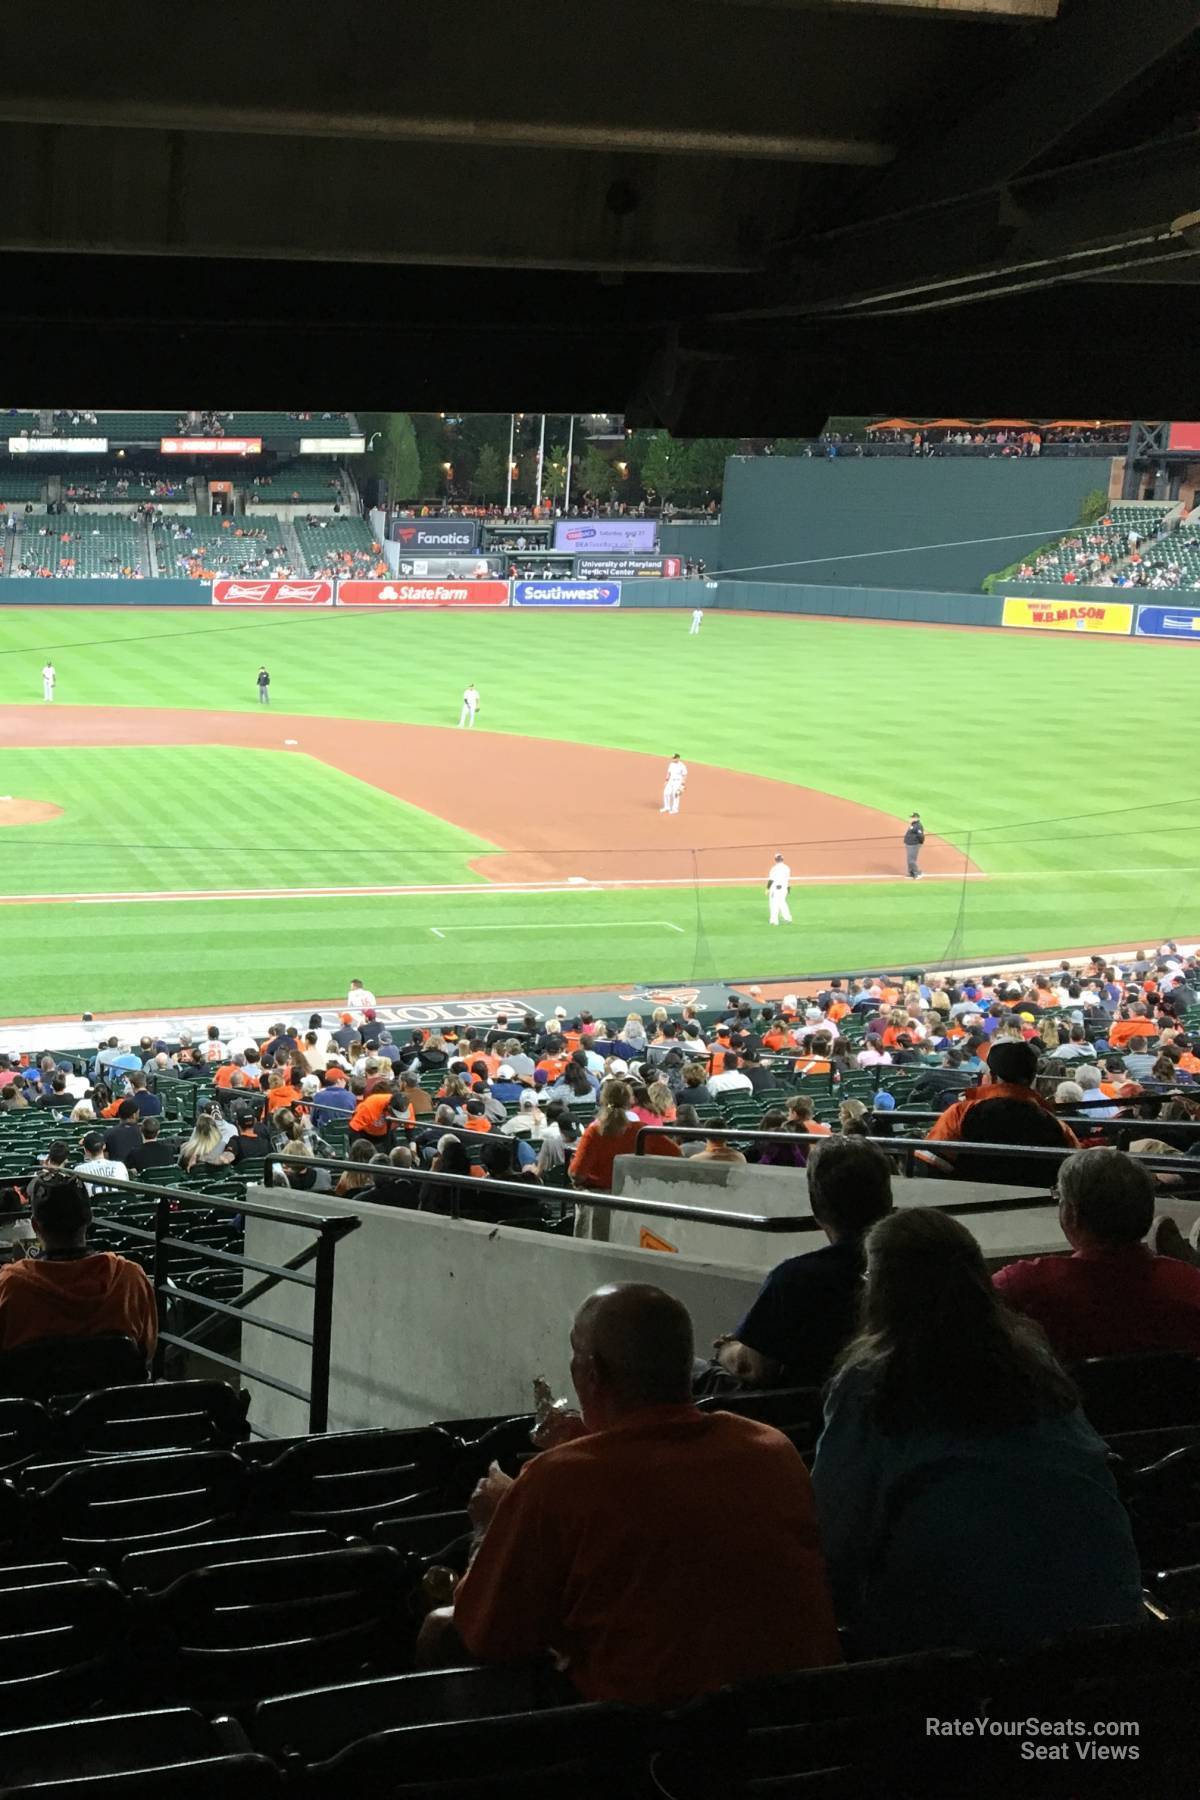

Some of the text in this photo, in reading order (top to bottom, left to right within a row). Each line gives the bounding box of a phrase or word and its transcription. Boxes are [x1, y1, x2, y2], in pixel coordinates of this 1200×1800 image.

[417, 532, 470, 544] Fanatics
[581, 560, 618, 569] University
[628, 560, 662, 569] Maryland
[609, 568, 635, 576] Center
[524, 586, 600, 600] Southwest
